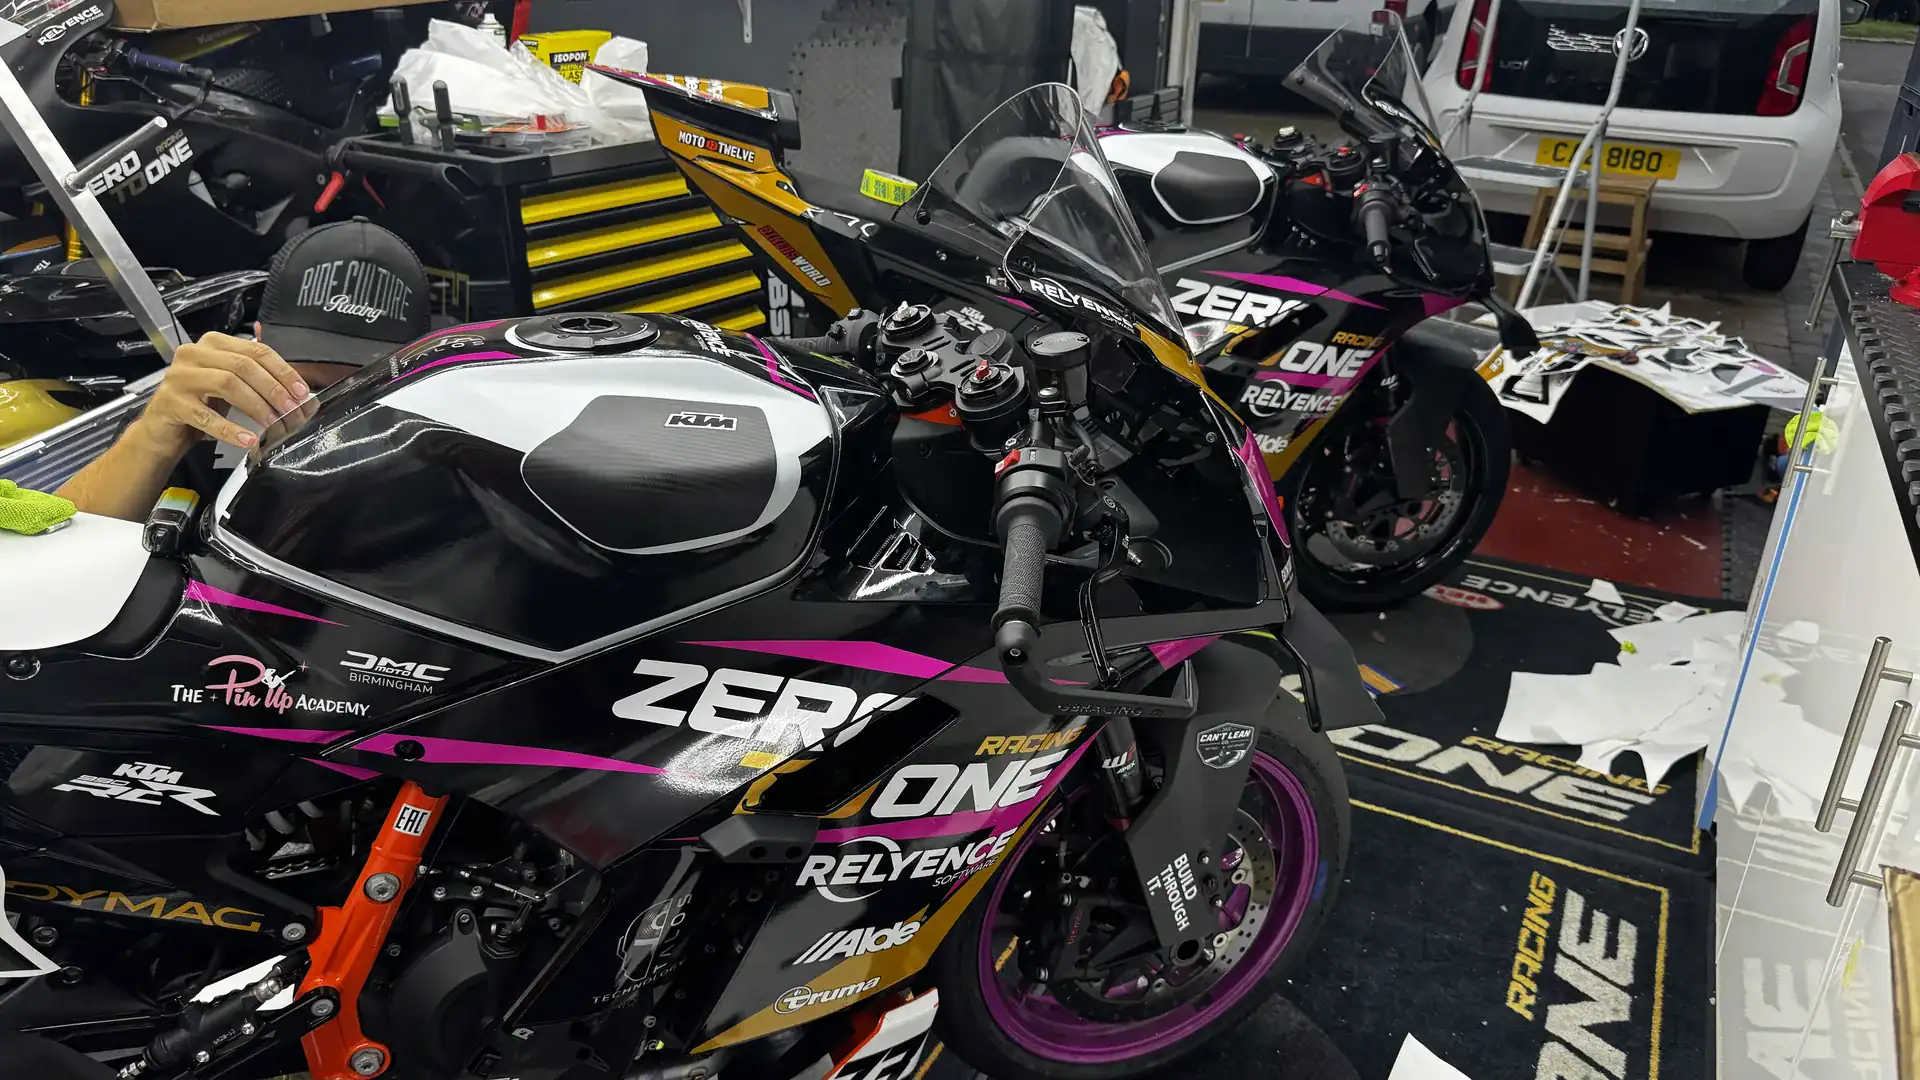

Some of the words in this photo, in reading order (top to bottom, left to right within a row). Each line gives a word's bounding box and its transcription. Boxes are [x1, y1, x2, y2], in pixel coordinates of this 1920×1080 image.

[37, 5, 102, 46] RELYENCE
[554, 51, 588, 64] ISOPON
[144, 135, 194, 185] ONE
[679, 130, 706, 149] MOTO
[718, 142, 755, 164] TWELVE
[1606, 147, 1663, 172] 8180
[88, 150, 142, 198] ERO
[792, 256, 833, 287] WORLD
[297, 260, 345, 306] RIDE
[342, 260, 413, 322] CULTURE
[323, 294, 383, 324] Racing
[1029, 278, 1134, 329] RELYENCE
[1279, 340, 1376, 378] ONE
[1240, 378, 1342, 417] RELYENCE
[668, 412, 735, 429] KTM
[171, 684, 204, 703] THE
[205, 654, 267, 707] Pin
[264, 682, 294, 715] Up
[295, 694, 371, 717] ACADEMY
[349, 672, 433, 694] BIRMINGHAM
[974, 725, 1087, 755] RACING
[1200, 732, 1228, 743] CAN'T
[1228, 730, 1252, 740] LEAN
[112, 761, 184, 785] KTM
[870, 748, 1070, 818] ONE
[1325, 723, 1657, 822] ONE
[395, 806, 428, 834] EAC
[795, 827, 1018, 902] RELYENCE
[932, 856, 999, 888] SOFTWARE
[1173, 853, 1198, 901] BUILD
[1146, 875, 1162, 896] IT.
[1160, 863, 1191, 932] THROUGH
[5, 880, 266, 933] DYMAG
[1505, 871, 1557, 1022] RACING
[776, 976, 881, 1013] truma
